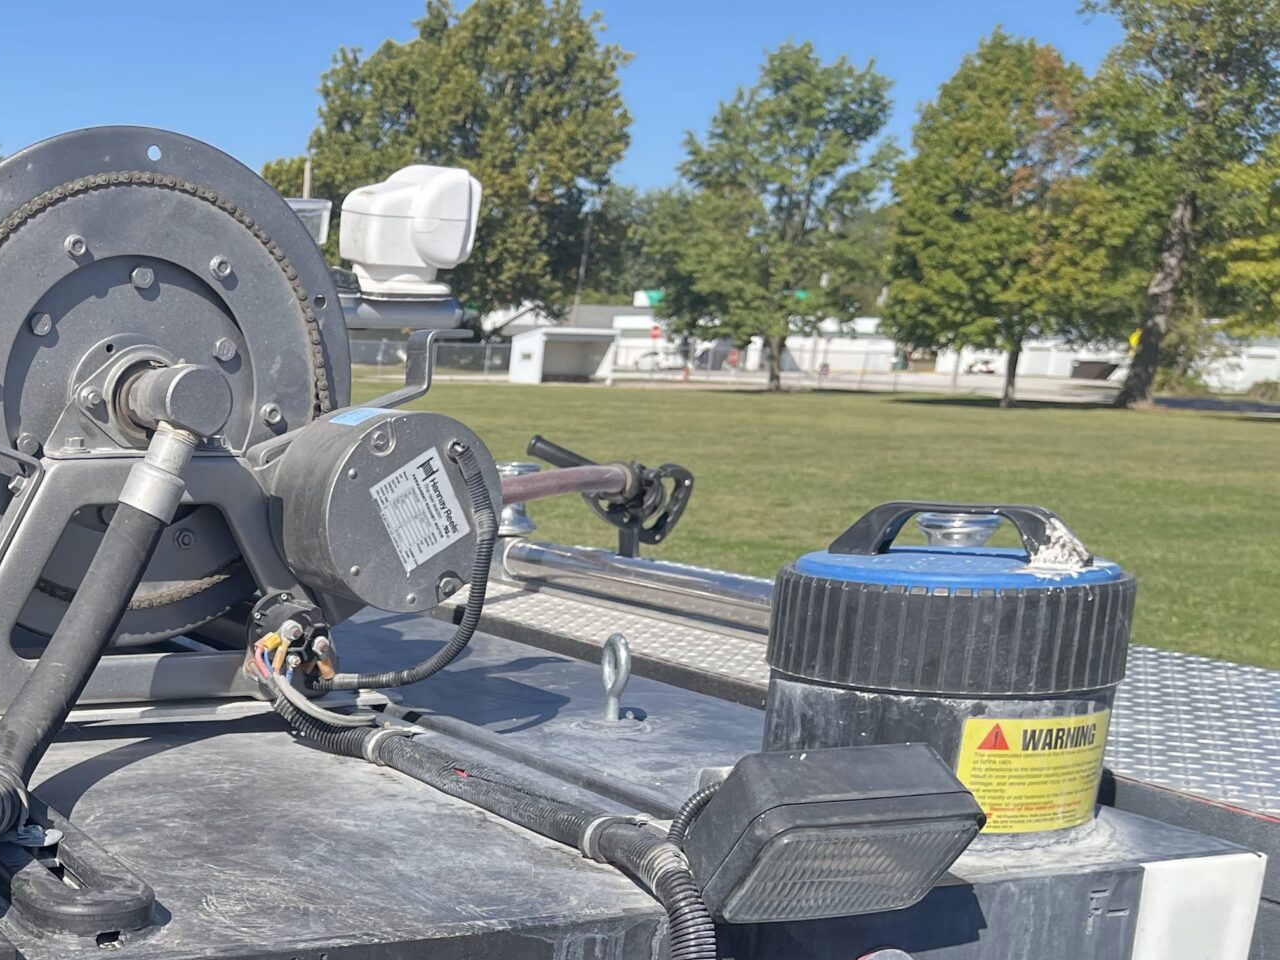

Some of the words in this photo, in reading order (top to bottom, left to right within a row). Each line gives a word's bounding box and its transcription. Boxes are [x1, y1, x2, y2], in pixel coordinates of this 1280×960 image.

[429, 477, 448, 511] Hannay
[443, 507, 459, 534] Reels
[1021, 723, 1097, 752] WARNING
